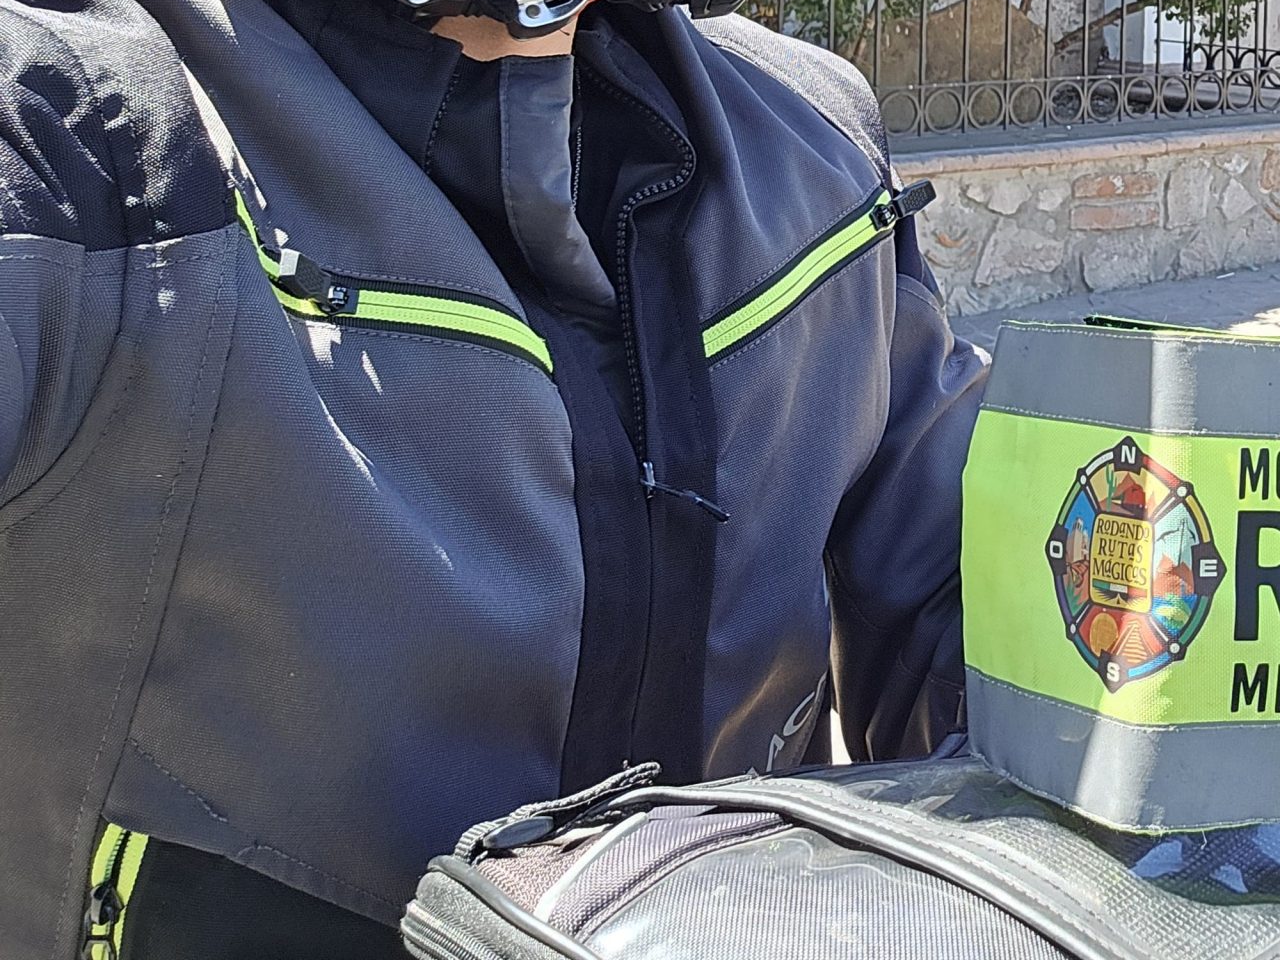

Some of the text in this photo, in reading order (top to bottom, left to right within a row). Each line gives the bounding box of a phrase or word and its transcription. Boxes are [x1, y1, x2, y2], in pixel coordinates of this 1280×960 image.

[1120, 444, 1136, 465] N
[1049, 540, 1064, 559] O
[1199, 558, 1218, 578] E
[1106, 661, 1120, 683] S
